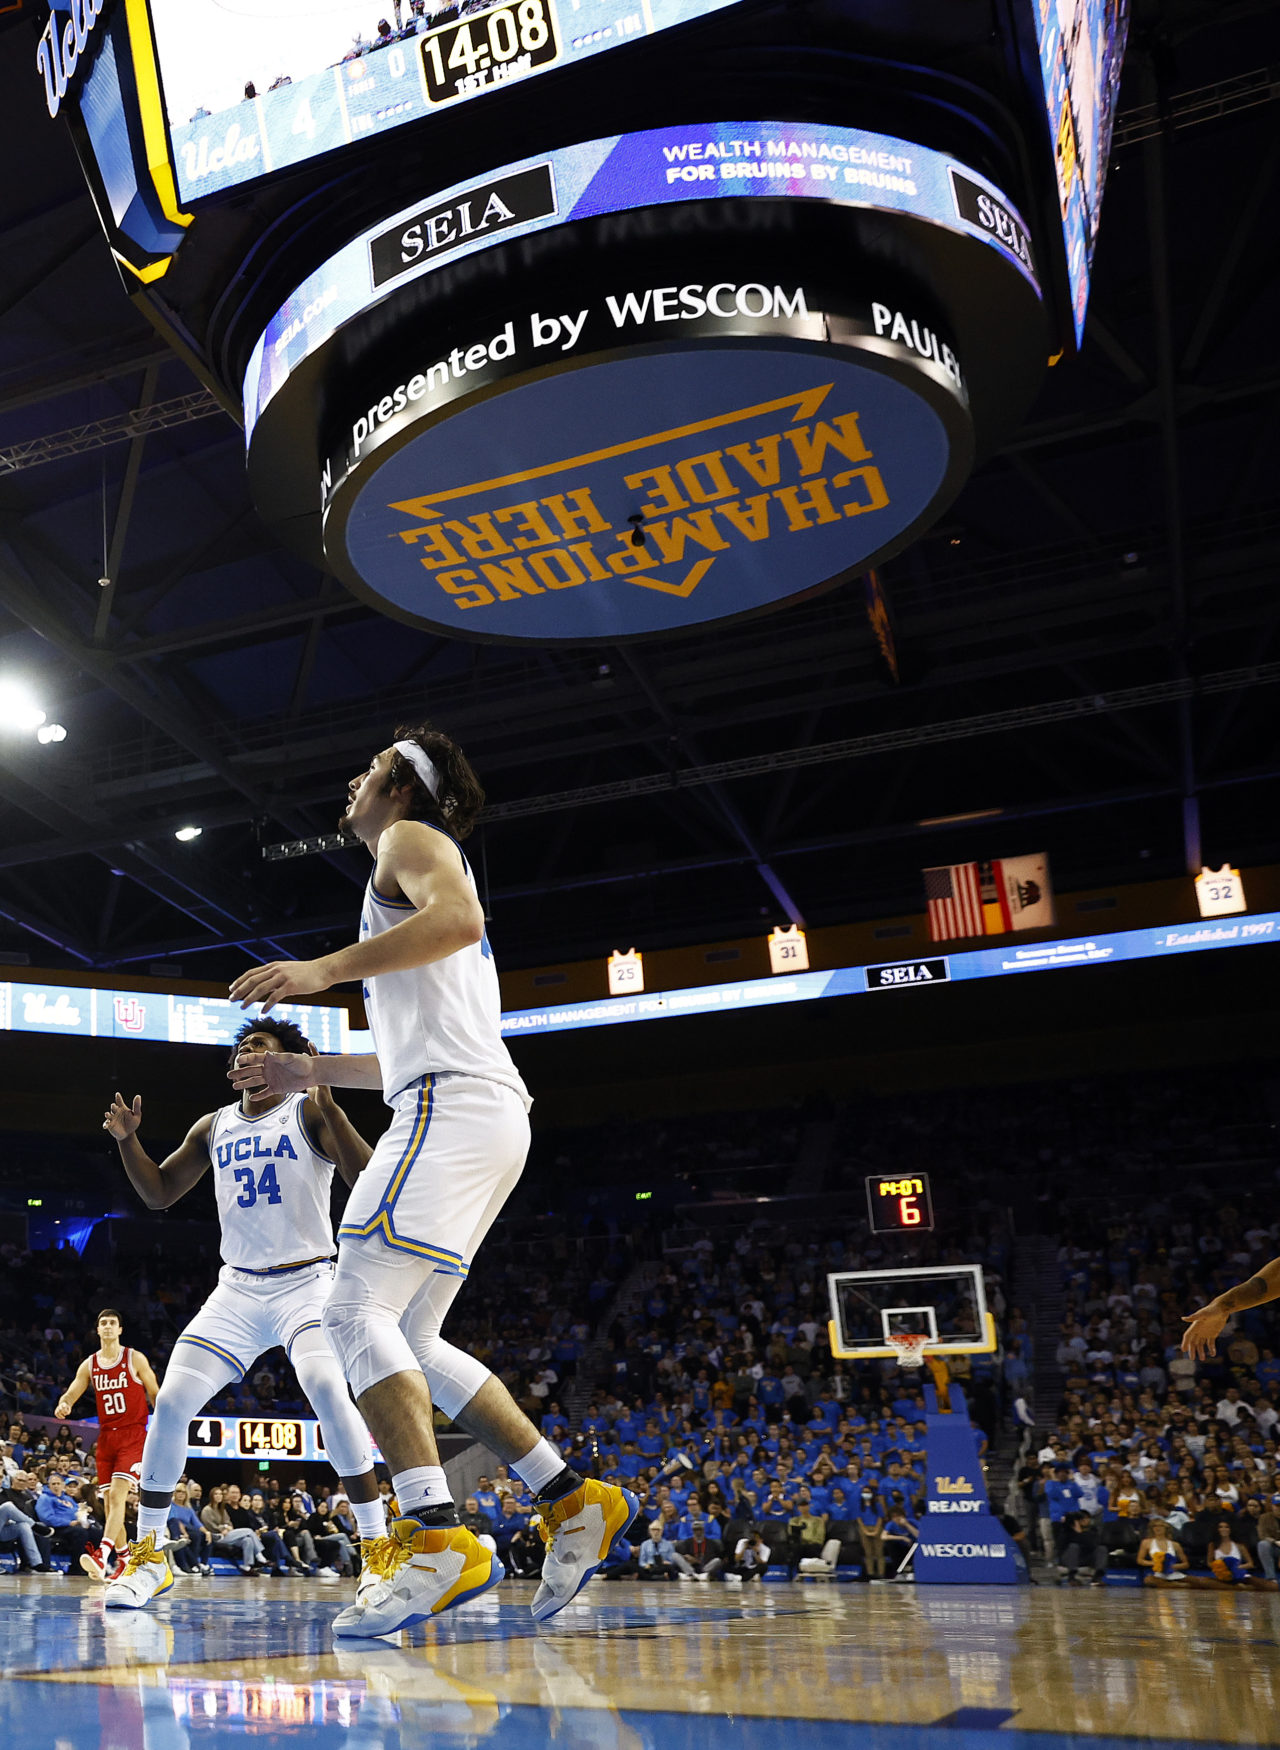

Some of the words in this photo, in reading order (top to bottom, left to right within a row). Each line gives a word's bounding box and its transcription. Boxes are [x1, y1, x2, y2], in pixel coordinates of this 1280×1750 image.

[424, 2, 549, 86] 14:08
[387, 47, 405, 79] 0
[291, 98, 317, 140] 4
[181, 123, 262, 182] Ucla
[662, 140, 762, 162] WEALTH
[767, 141, 914, 176] MANAGEMENT
[666, 165, 715, 185] FOR
[725, 160, 807, 180] BRUINS
[809, 162, 839, 183] BY
[844, 167, 918, 197] BRUINS
[400, 192, 516, 264] SEIA
[976, 194, 1035, 273] SEIA
[352, 320, 517, 457] presented
[531, 308, 589, 352] by
[605, 283, 810, 328] WESCOM
[624, 411, 874, 519] MADE
[398, 488, 614, 571] HERE
[435, 465, 891, 611] CHAMPIONS
[1209, 886, 1233, 900] 32
[780, 946, 798, 959] 31
[617, 968, 635, 981] 25
[880, 964, 933, 985] SEIA
[216, 1135, 299, 1169] UCLA
[233, 1163, 282, 1209] 34
[900, 1197, 921, 1225] 6
[93, 1371, 129, 1392] Utah
[102, 1392, 127, 1415] 20
[197, 1420, 212, 1444] 4
[242, 1422, 297, 1450] 14:08
[928, 1500, 982, 1513] READY
[920, 1543, 989, 1558] WESCOM
